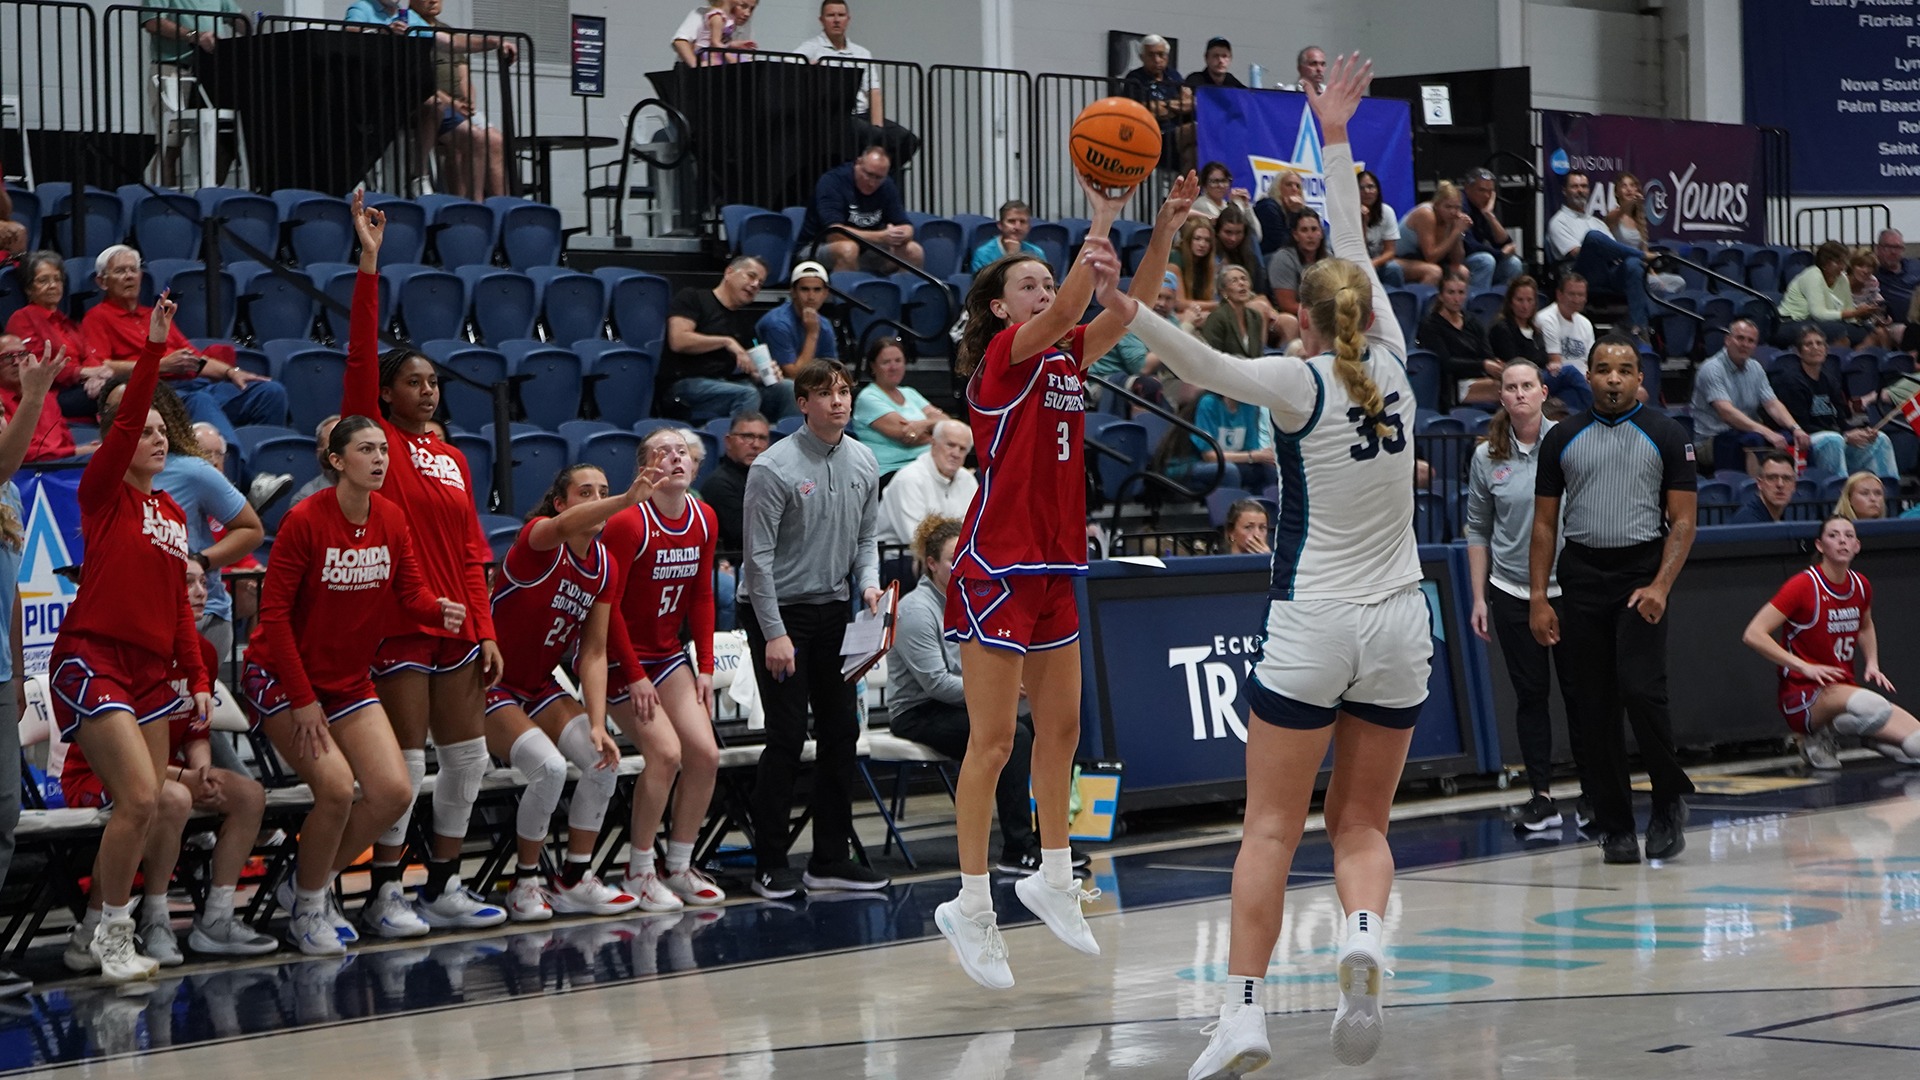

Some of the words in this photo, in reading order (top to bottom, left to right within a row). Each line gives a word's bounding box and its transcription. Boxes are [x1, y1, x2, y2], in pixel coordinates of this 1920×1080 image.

[1858, 14, 1914, 28] Florida
[1841, 78, 1879, 92] Nova
[1837, 99, 1877, 113] Palm
[1878, 141, 1919, 155] Saint
[1085, 146, 1145, 175] Wilson
[1668, 161, 1749, 234] YOURS
[1057, 421, 1071, 461] 3
[325, 545, 392, 569] FLORIDA
[655, 546, 700, 564] FLORIDA
[321, 564, 391, 584] SOUTHERN
[657, 584, 684, 618] 51
[543, 617, 575, 647] 21
[1213, 634, 1256, 656] ECK
[1833, 636, 1855, 663] 45
